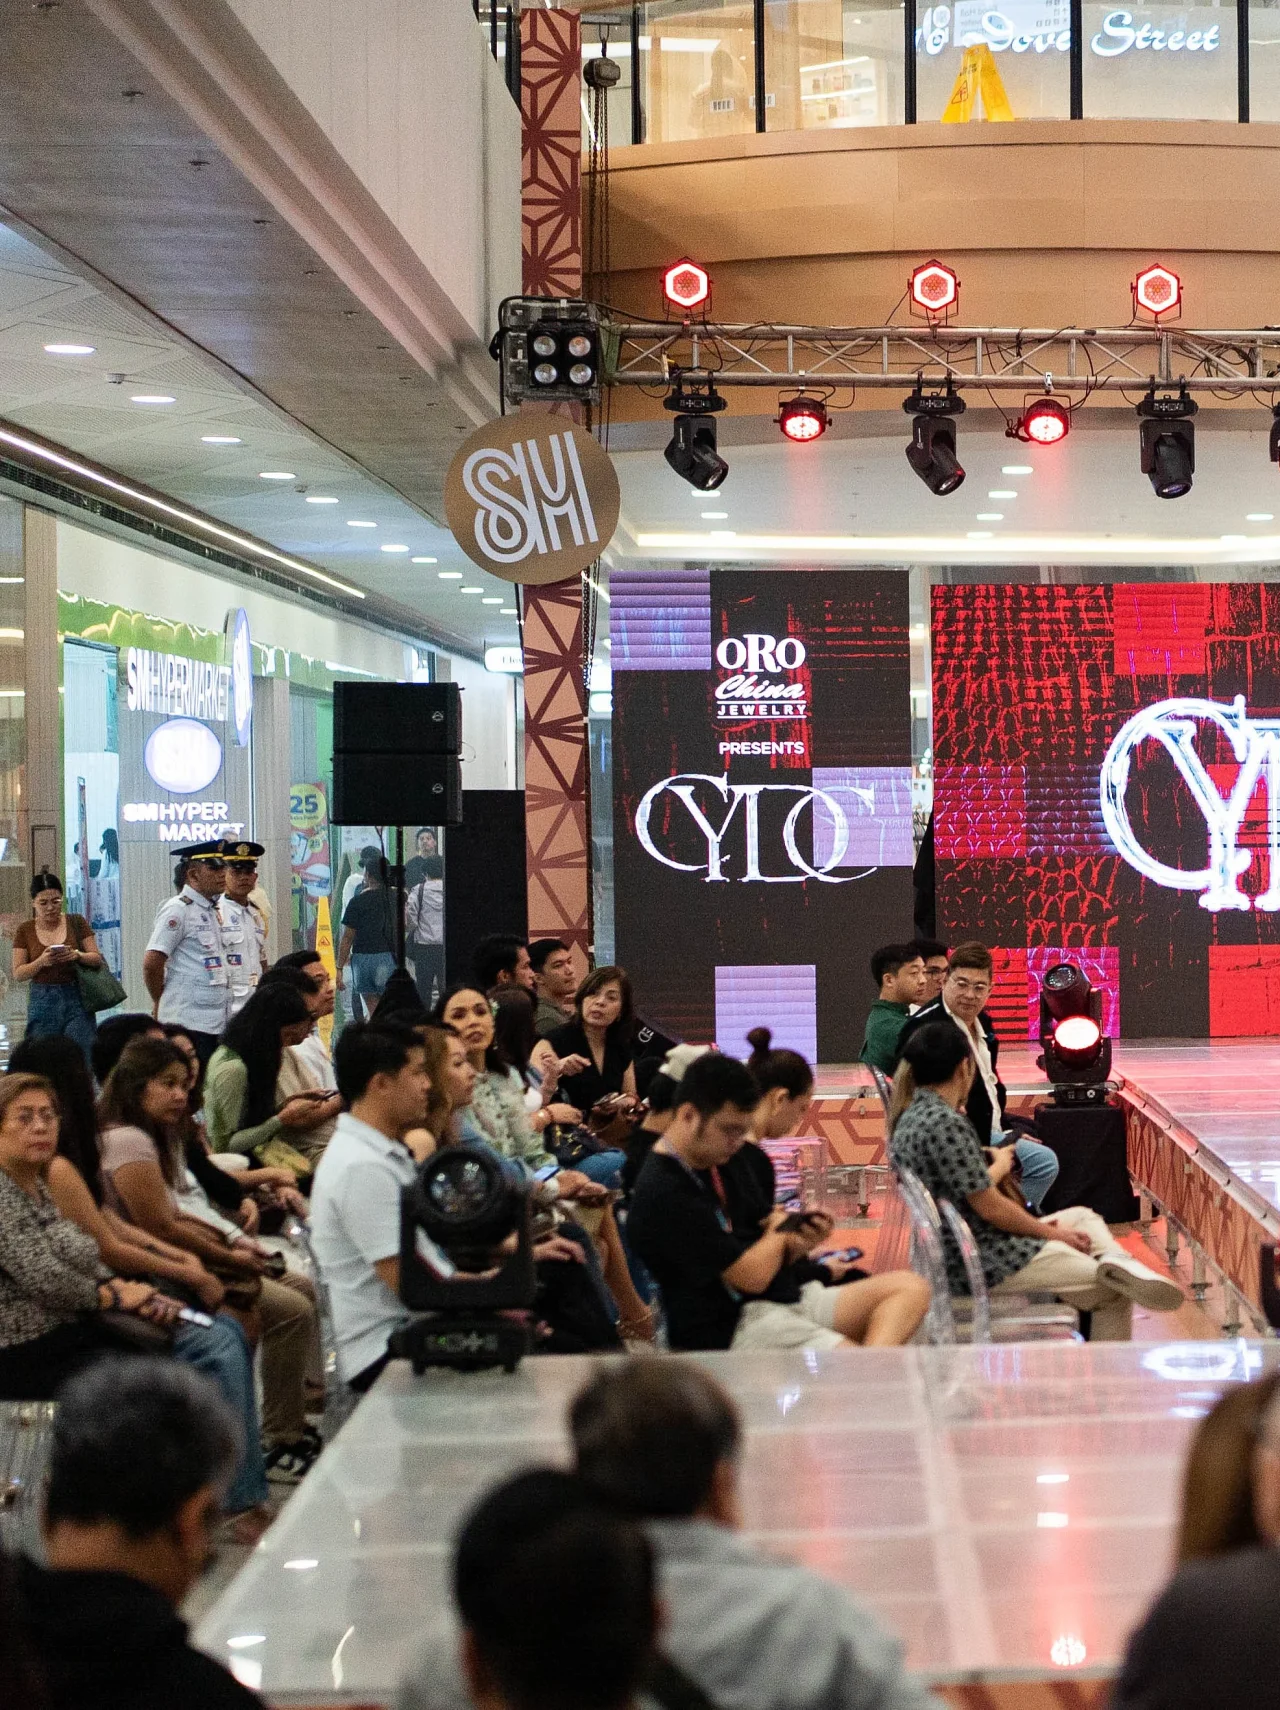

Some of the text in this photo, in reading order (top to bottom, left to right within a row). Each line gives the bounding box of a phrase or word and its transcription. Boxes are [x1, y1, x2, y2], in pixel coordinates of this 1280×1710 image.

[1091, 10, 1219, 56] Street
[463, 431, 598, 563] SM
[715, 674, 805, 700] China
[717, 704, 807, 716] JEWELRY
[719, 741, 805, 755] PRESENTS
[290, 794, 318, 814] 25
